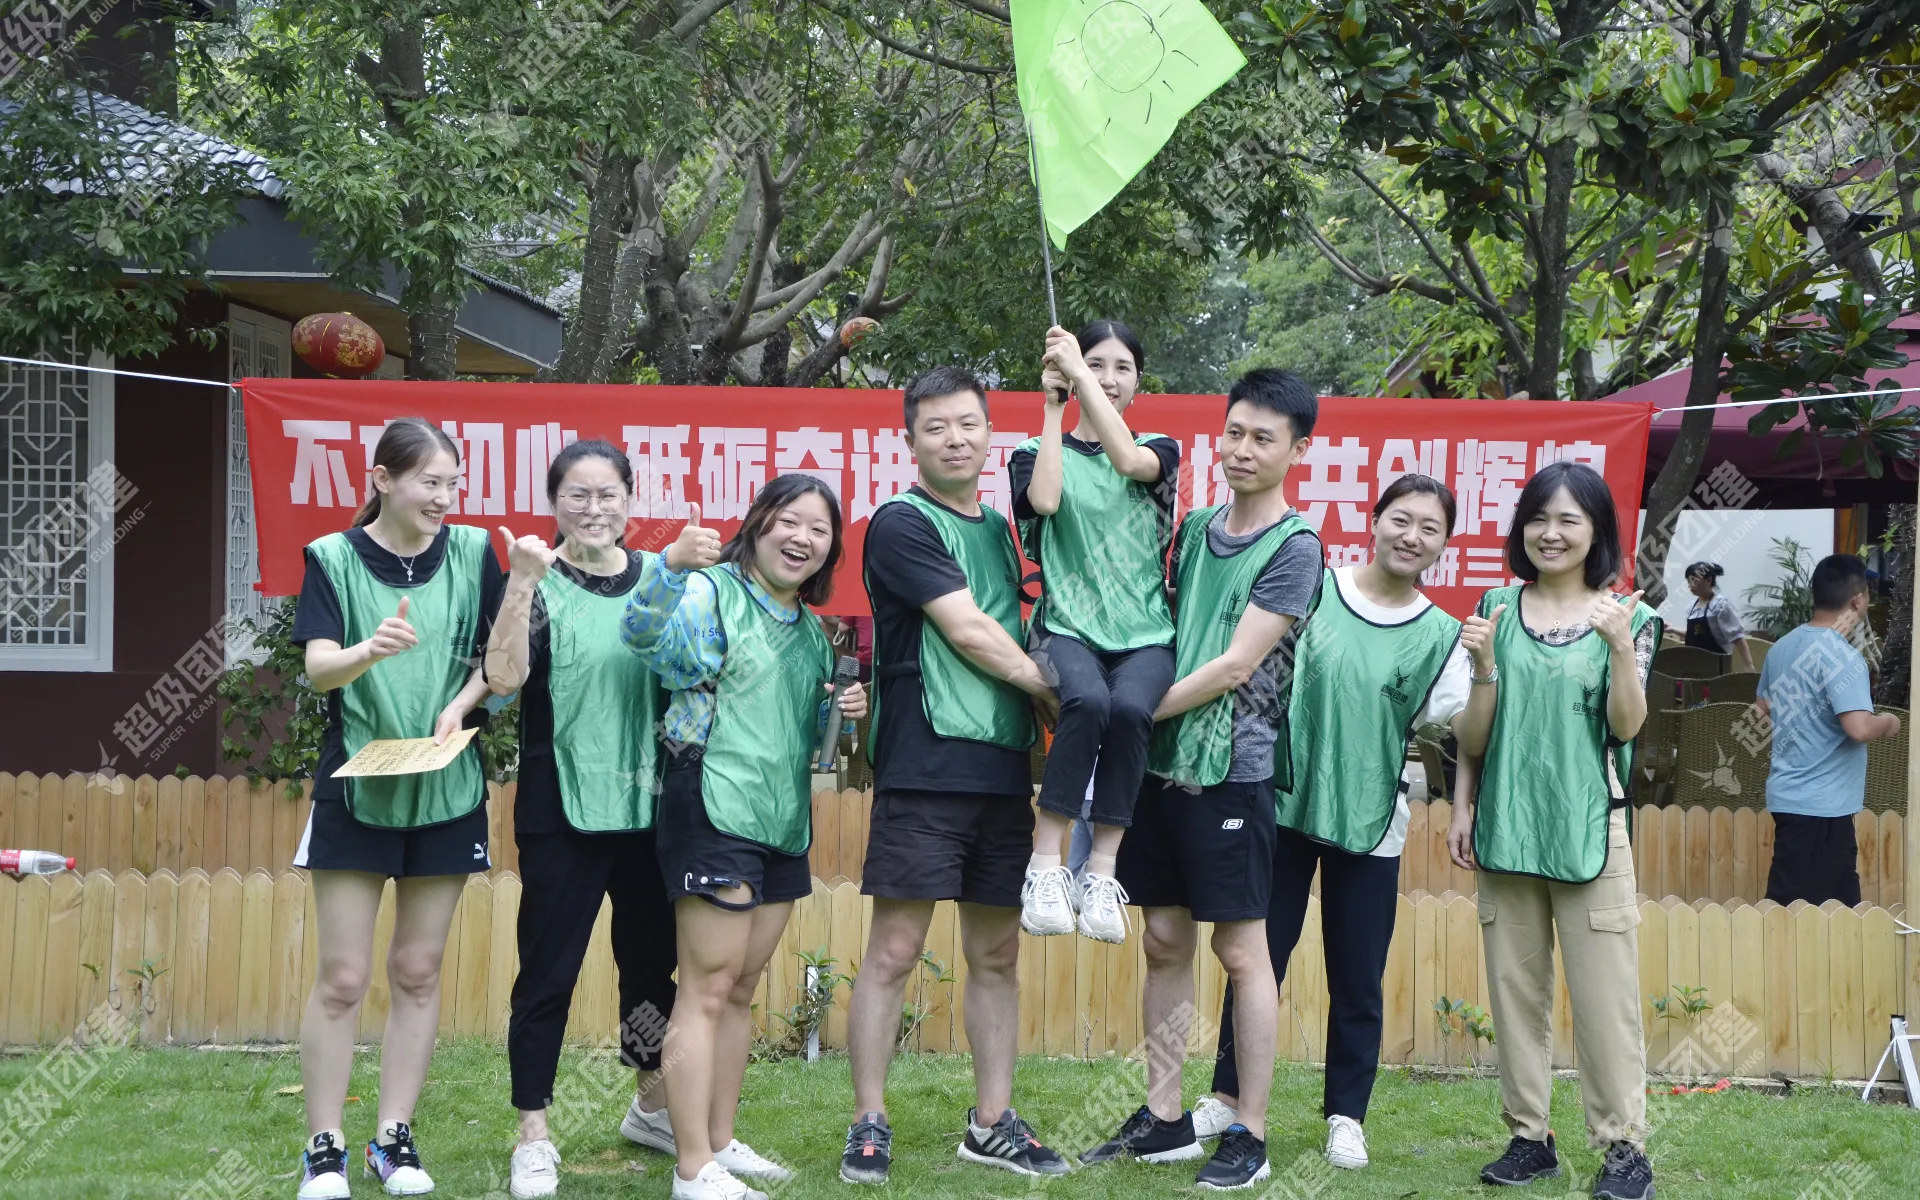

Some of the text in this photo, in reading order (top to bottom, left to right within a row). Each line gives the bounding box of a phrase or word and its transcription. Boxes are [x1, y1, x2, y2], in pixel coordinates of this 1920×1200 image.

[281, 419, 579, 517] 不初心
[1298, 436, 1607, 538] 共创辉
